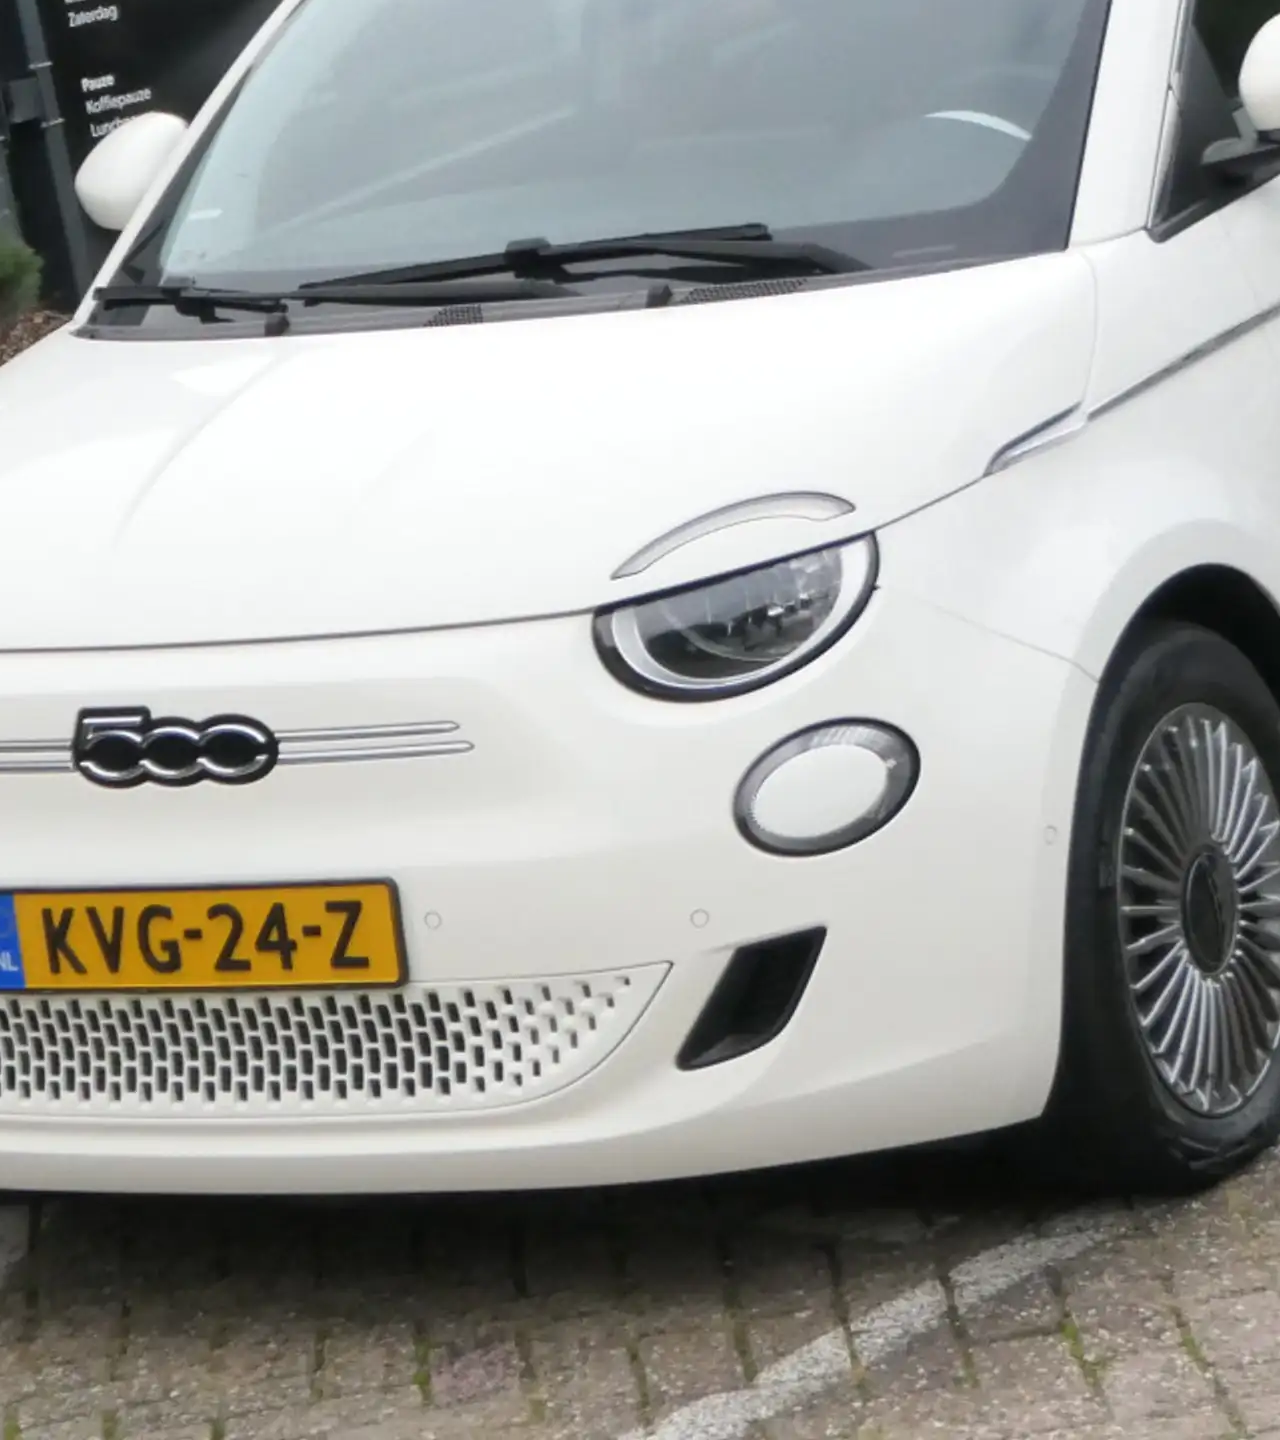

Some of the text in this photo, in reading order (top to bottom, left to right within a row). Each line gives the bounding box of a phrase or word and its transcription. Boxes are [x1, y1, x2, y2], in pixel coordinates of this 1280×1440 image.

[67, 5, 119, 27] Zaterdag
[81, 75, 115, 93] Pauze
[73, 706, 278, 788] 500
[41, 900, 370, 976] KVG-24-Z
